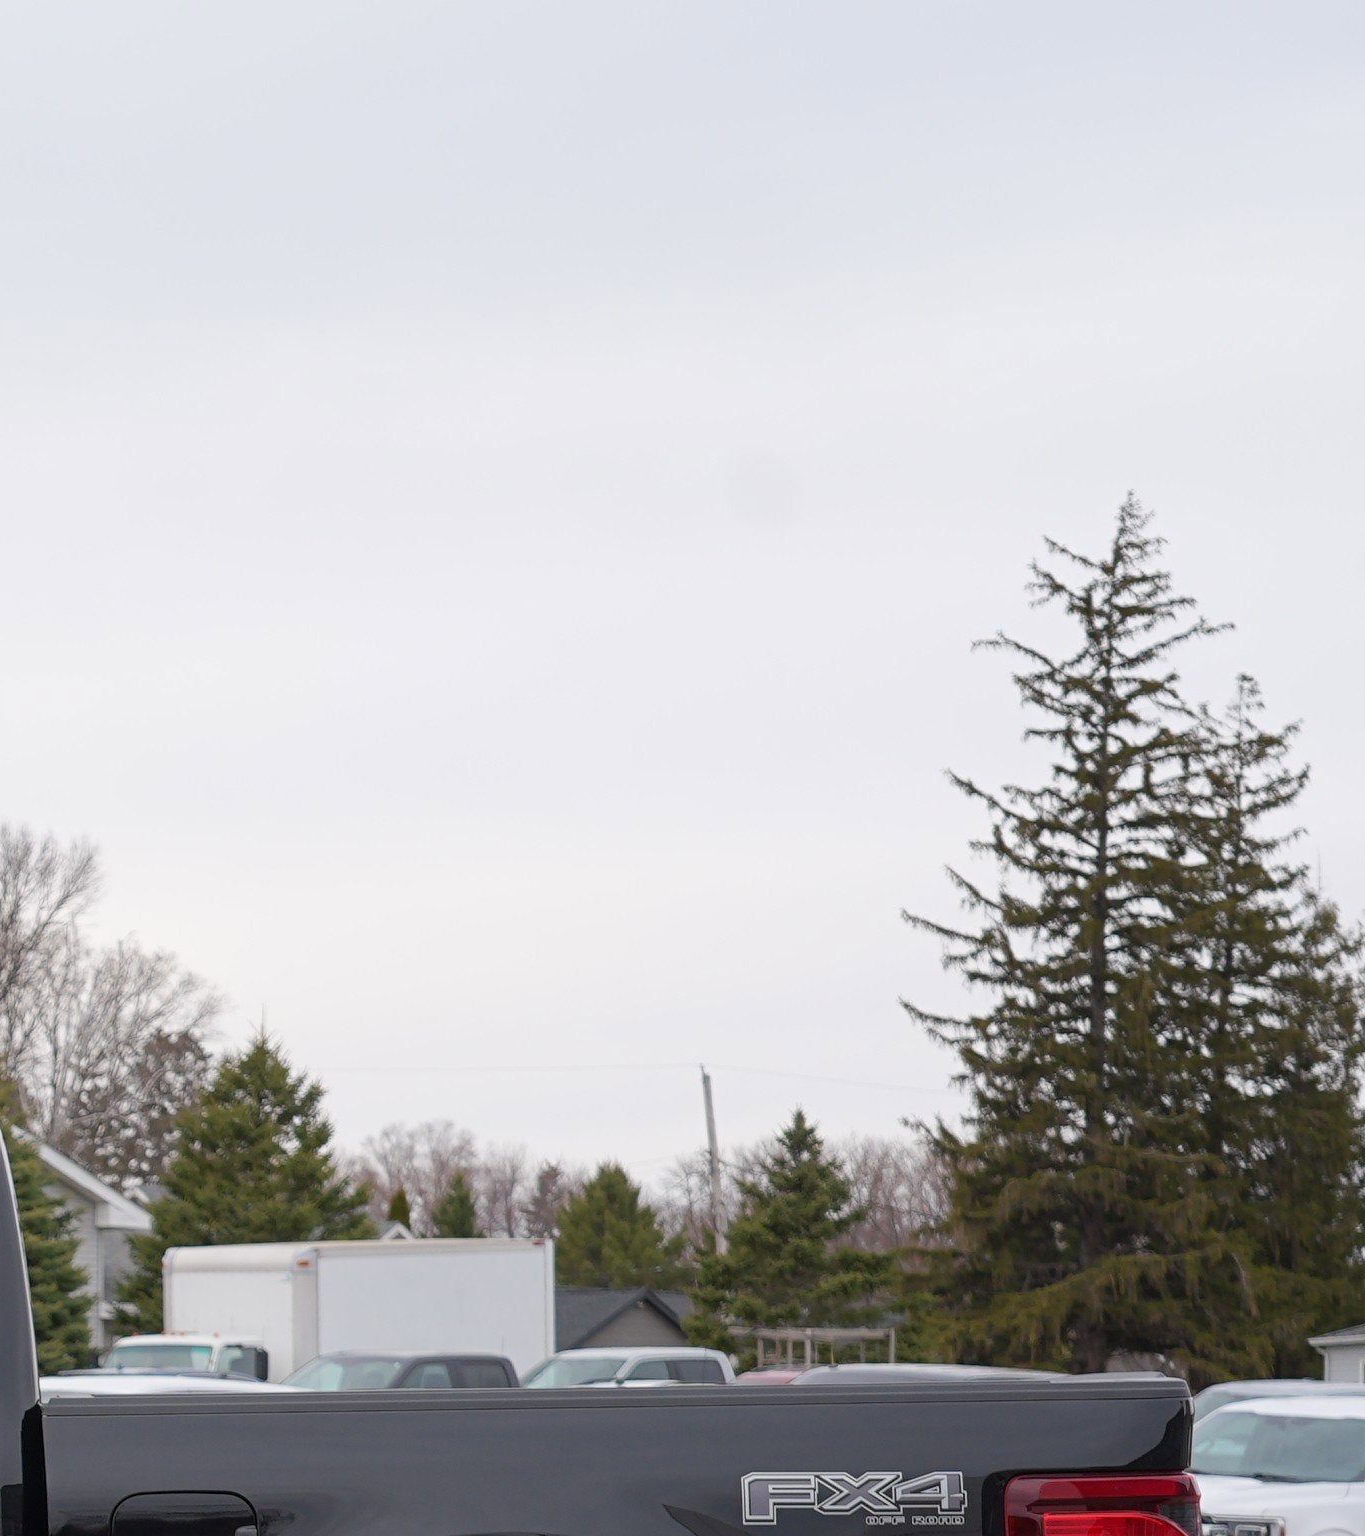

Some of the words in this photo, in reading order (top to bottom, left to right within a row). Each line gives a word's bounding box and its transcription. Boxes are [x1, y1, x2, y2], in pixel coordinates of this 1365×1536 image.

[741, 1471, 968, 1525] FX4
[866, 1516, 906, 1525] OFF
[912, 1516, 965, 1525] ROAD
